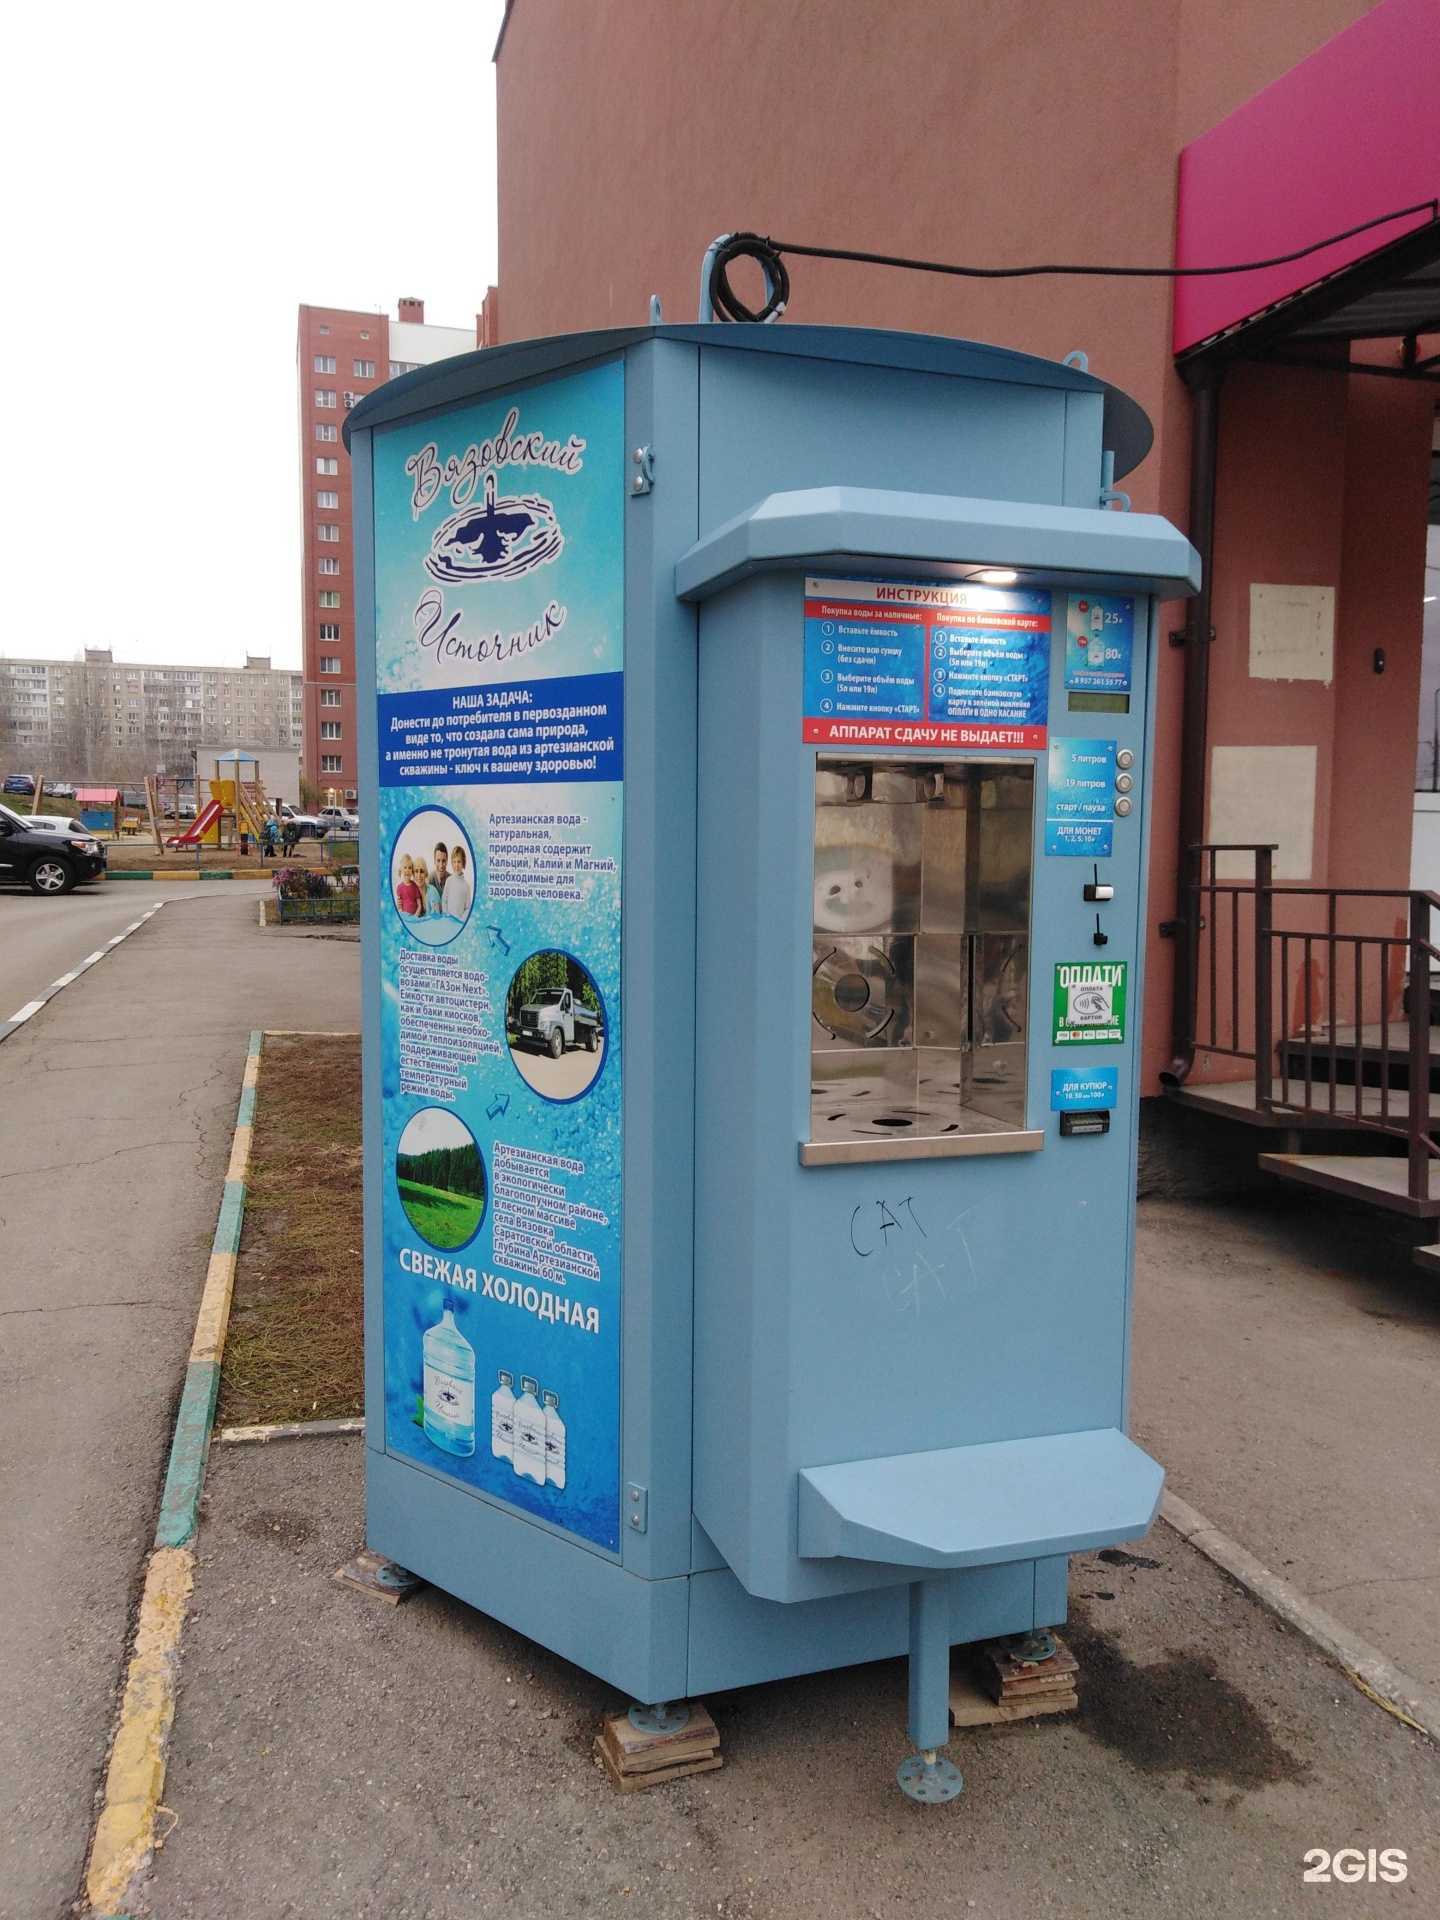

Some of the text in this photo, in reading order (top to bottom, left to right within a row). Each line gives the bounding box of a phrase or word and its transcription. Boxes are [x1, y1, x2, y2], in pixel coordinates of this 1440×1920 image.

[407, 408, 584, 511] Вязовский
[876, 587, 967, 605] ИНСТРУКЦИЯ
[822, 605, 852, 616] Покупка
[853, 609, 873, 617] воды
[414, 589, 566, 664] Источник
[452, 691, 533, 710] НАША ЗАДАЧА:
[391, 703, 607, 732] Донести до потребителя в первозданном
[405, 723, 588, 745] виде то, что создала сама природа,
[829, 725, 1024, 745] АППАРАТ СДАЧУ НЕ ВЫДАЕТ!!!
[386, 738, 614, 761] а именно не тронутая вода из артезианской
[1072, 754, 1107, 764] 5 литров
[400, 763, 448, 776] скважины
[455, 763, 481, 774] ключ
[483, 763, 489, 772] к
[491, 760, 532, 774] вашему
[535, 756, 596, 774] здоровью!
[1065, 779, 1106, 788] 19 литров
[1056, 803, 1105, 812] старт пауза
[489, 814, 580, 828] Артезианская вода
[489, 829, 551, 841] натуральная,
[1057, 827, 1102, 835] ДЛЯ МОНЕТ
[489, 844, 591, 856] природная содержит
[489, 856, 616, 872] Кальций, Калий и Магний,
[489, 871, 574, 886] необходимые для
[489, 887, 583, 900] здоровья человека.
[400, 950, 458, 965] Доставка воды
[400, 965, 488, 981] осуществляется водо-
[1060, 966, 1122, 988] ОПЛАТИ
[400, 978, 430, 988] возами
[401, 1005, 414, 1014] как
[416, 1006, 421, 1014] и
[423, 1006, 442, 1017] баки
[401, 1017, 490, 1038] обеспеченны необхо-
[401, 1030, 428, 1042] димой
[401, 1043, 477, 1063] поддерживающей
[401, 1057, 458, 1073] естественный
[401, 1069, 467, 1088] температурный
[1063, 1081, 1107, 1092] ДЛЯ КУПЮР
[401, 1084, 455, 1100] режим воды.
[494, 1142, 584, 1172] Артезианская вода
[494, 1158, 549, 1178] добывается
[502, 1173, 565, 1196] экологически
[494, 1184, 608, 1225] благополучном районе,
[494, 1200, 576, 1229] в лесном массиве
[494, 1214, 554, 1237] села Вязовка
[494, 1225, 597, 1264] Саратовской области.
[494, 1238, 600, 1280] Глубина Артезианской
[494, 1255, 541, 1275] скважины
[542, 1269, 554, 1280] 60
[399, 1247, 600, 1334] СВЕЖАЯ ХОЛОДНАЯ
